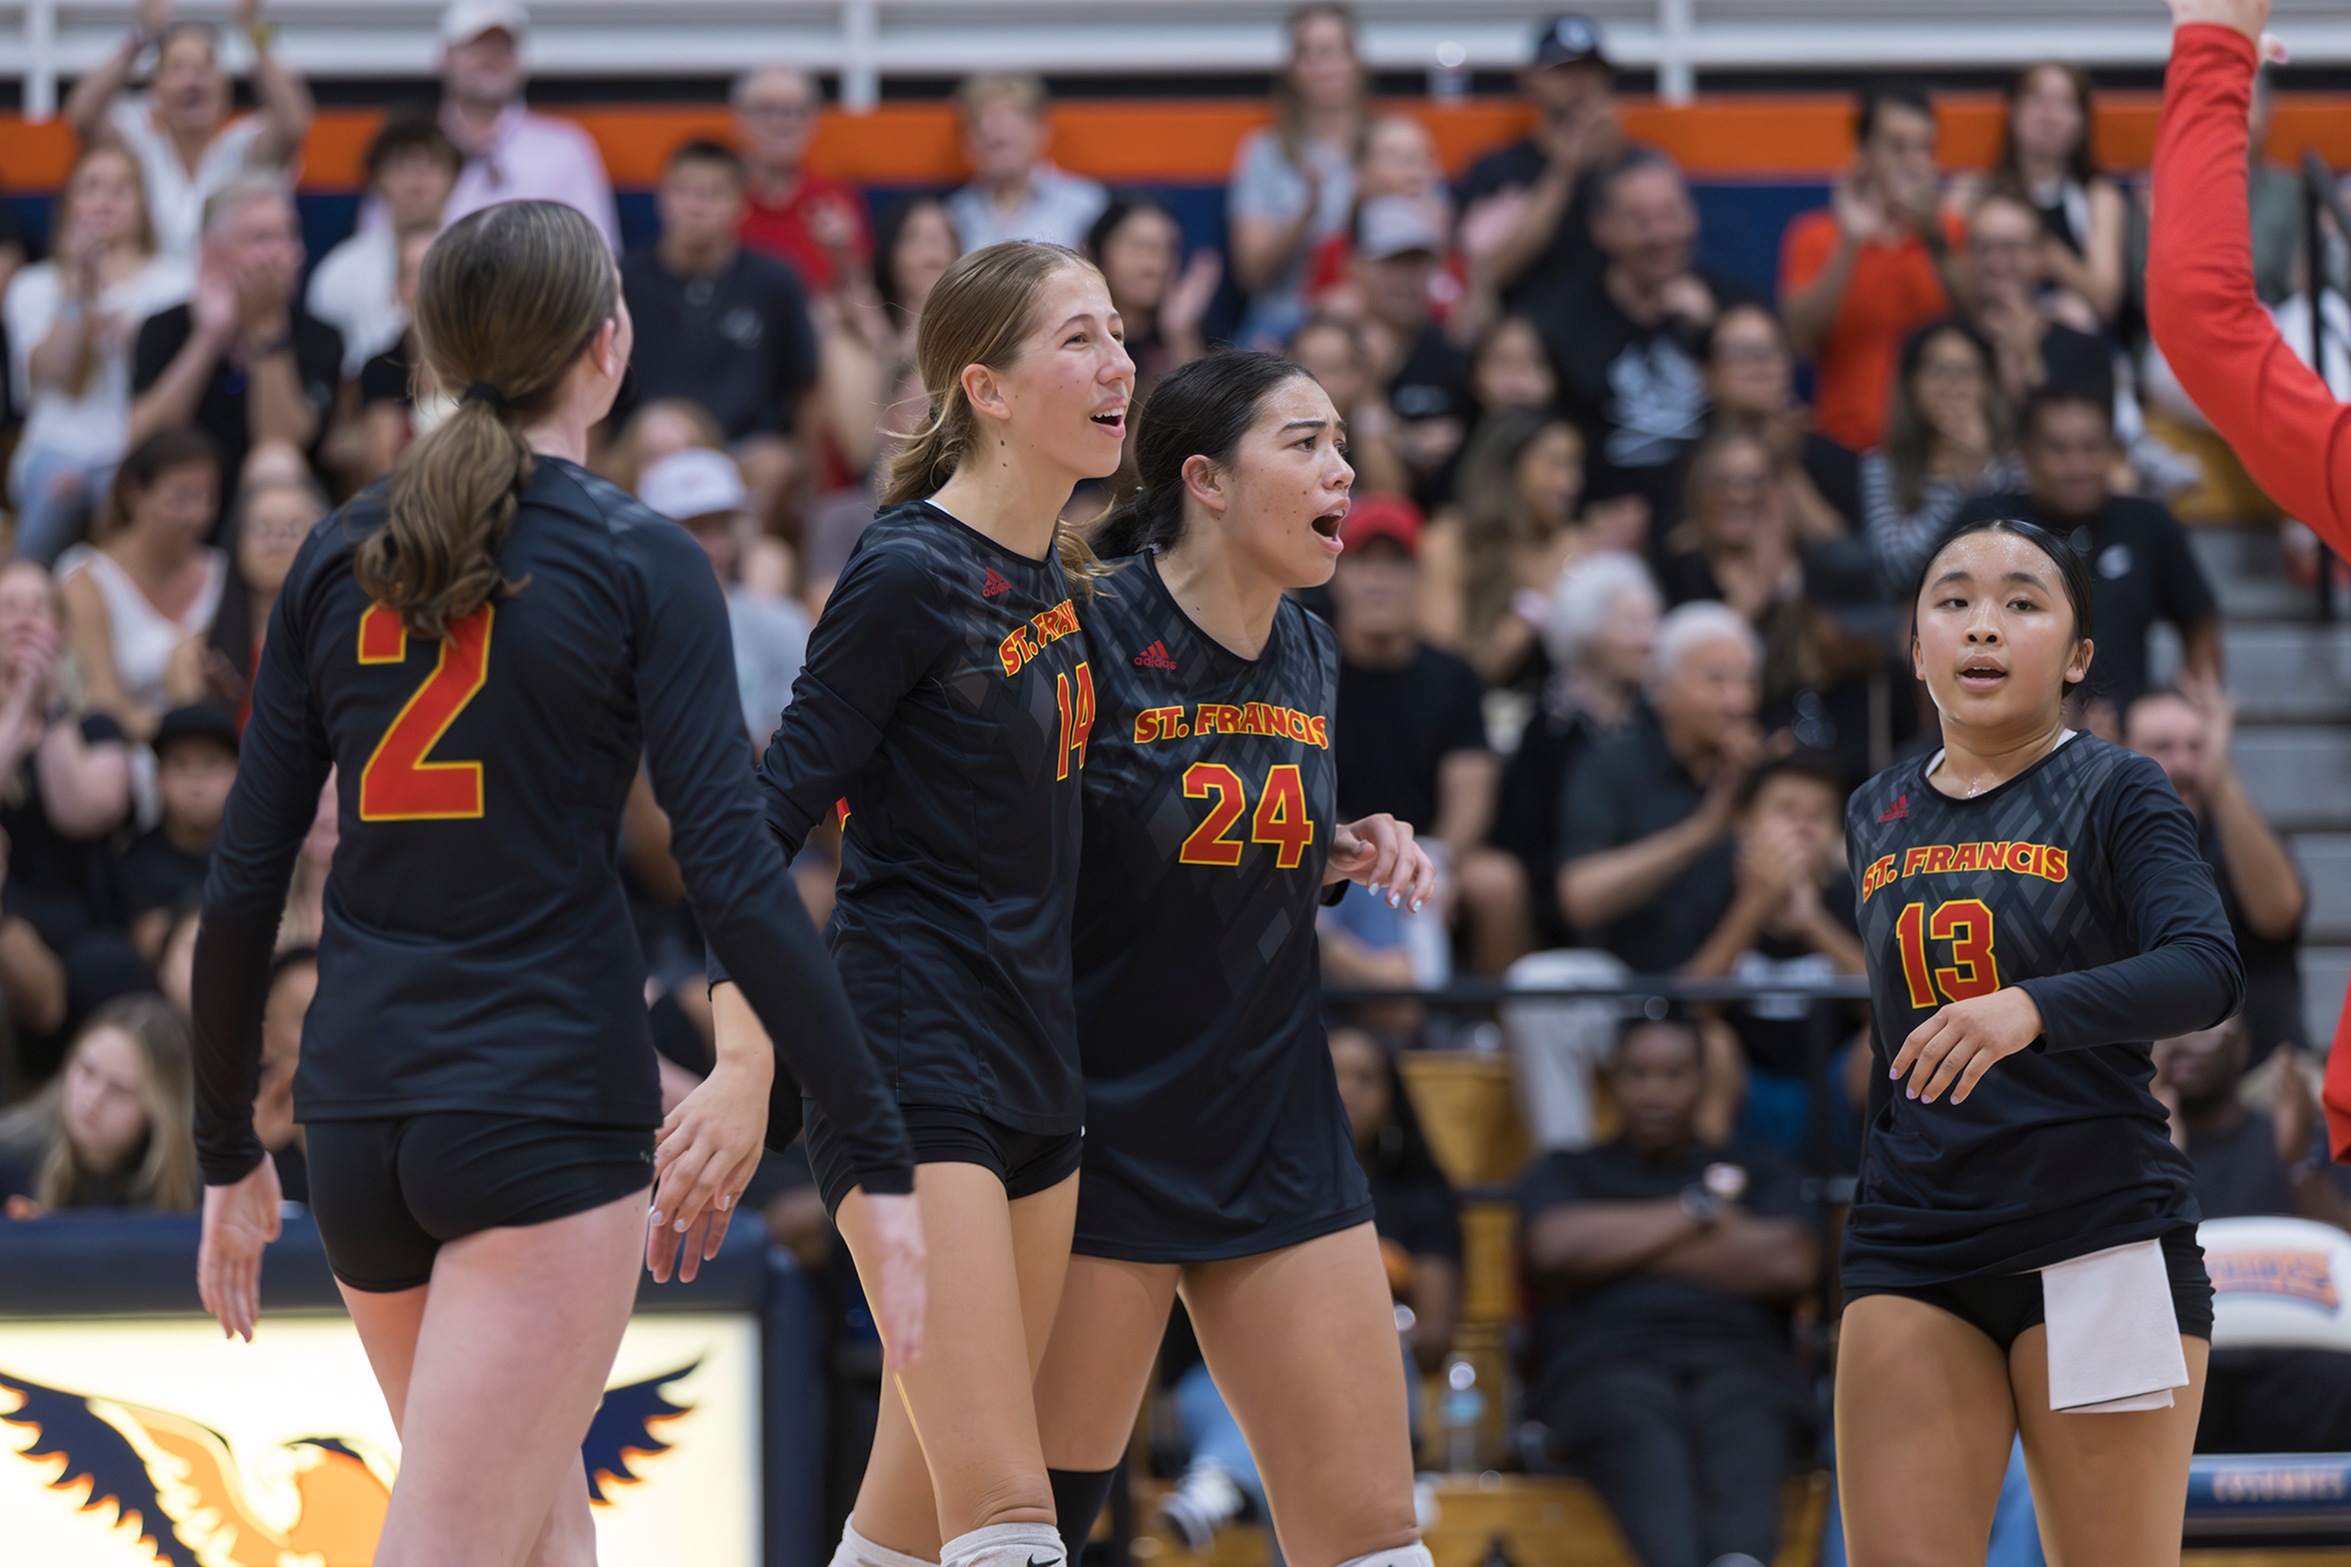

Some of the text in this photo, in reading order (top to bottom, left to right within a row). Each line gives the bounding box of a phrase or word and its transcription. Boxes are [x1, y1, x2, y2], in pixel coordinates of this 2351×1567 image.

[999, 598, 1081, 678] ST. FRAN
[1133, 656, 1177, 671] adidas
[358, 598, 494, 821] 2
[1057, 661, 1096, 781] 14
[1134, 702, 1329, 750] ST. FRANCIS
[1178, 761, 1314, 868] 24
[1863, 841, 2068, 904] ST. FRANCIS
[1896, 898, 2001, 1009] 13
